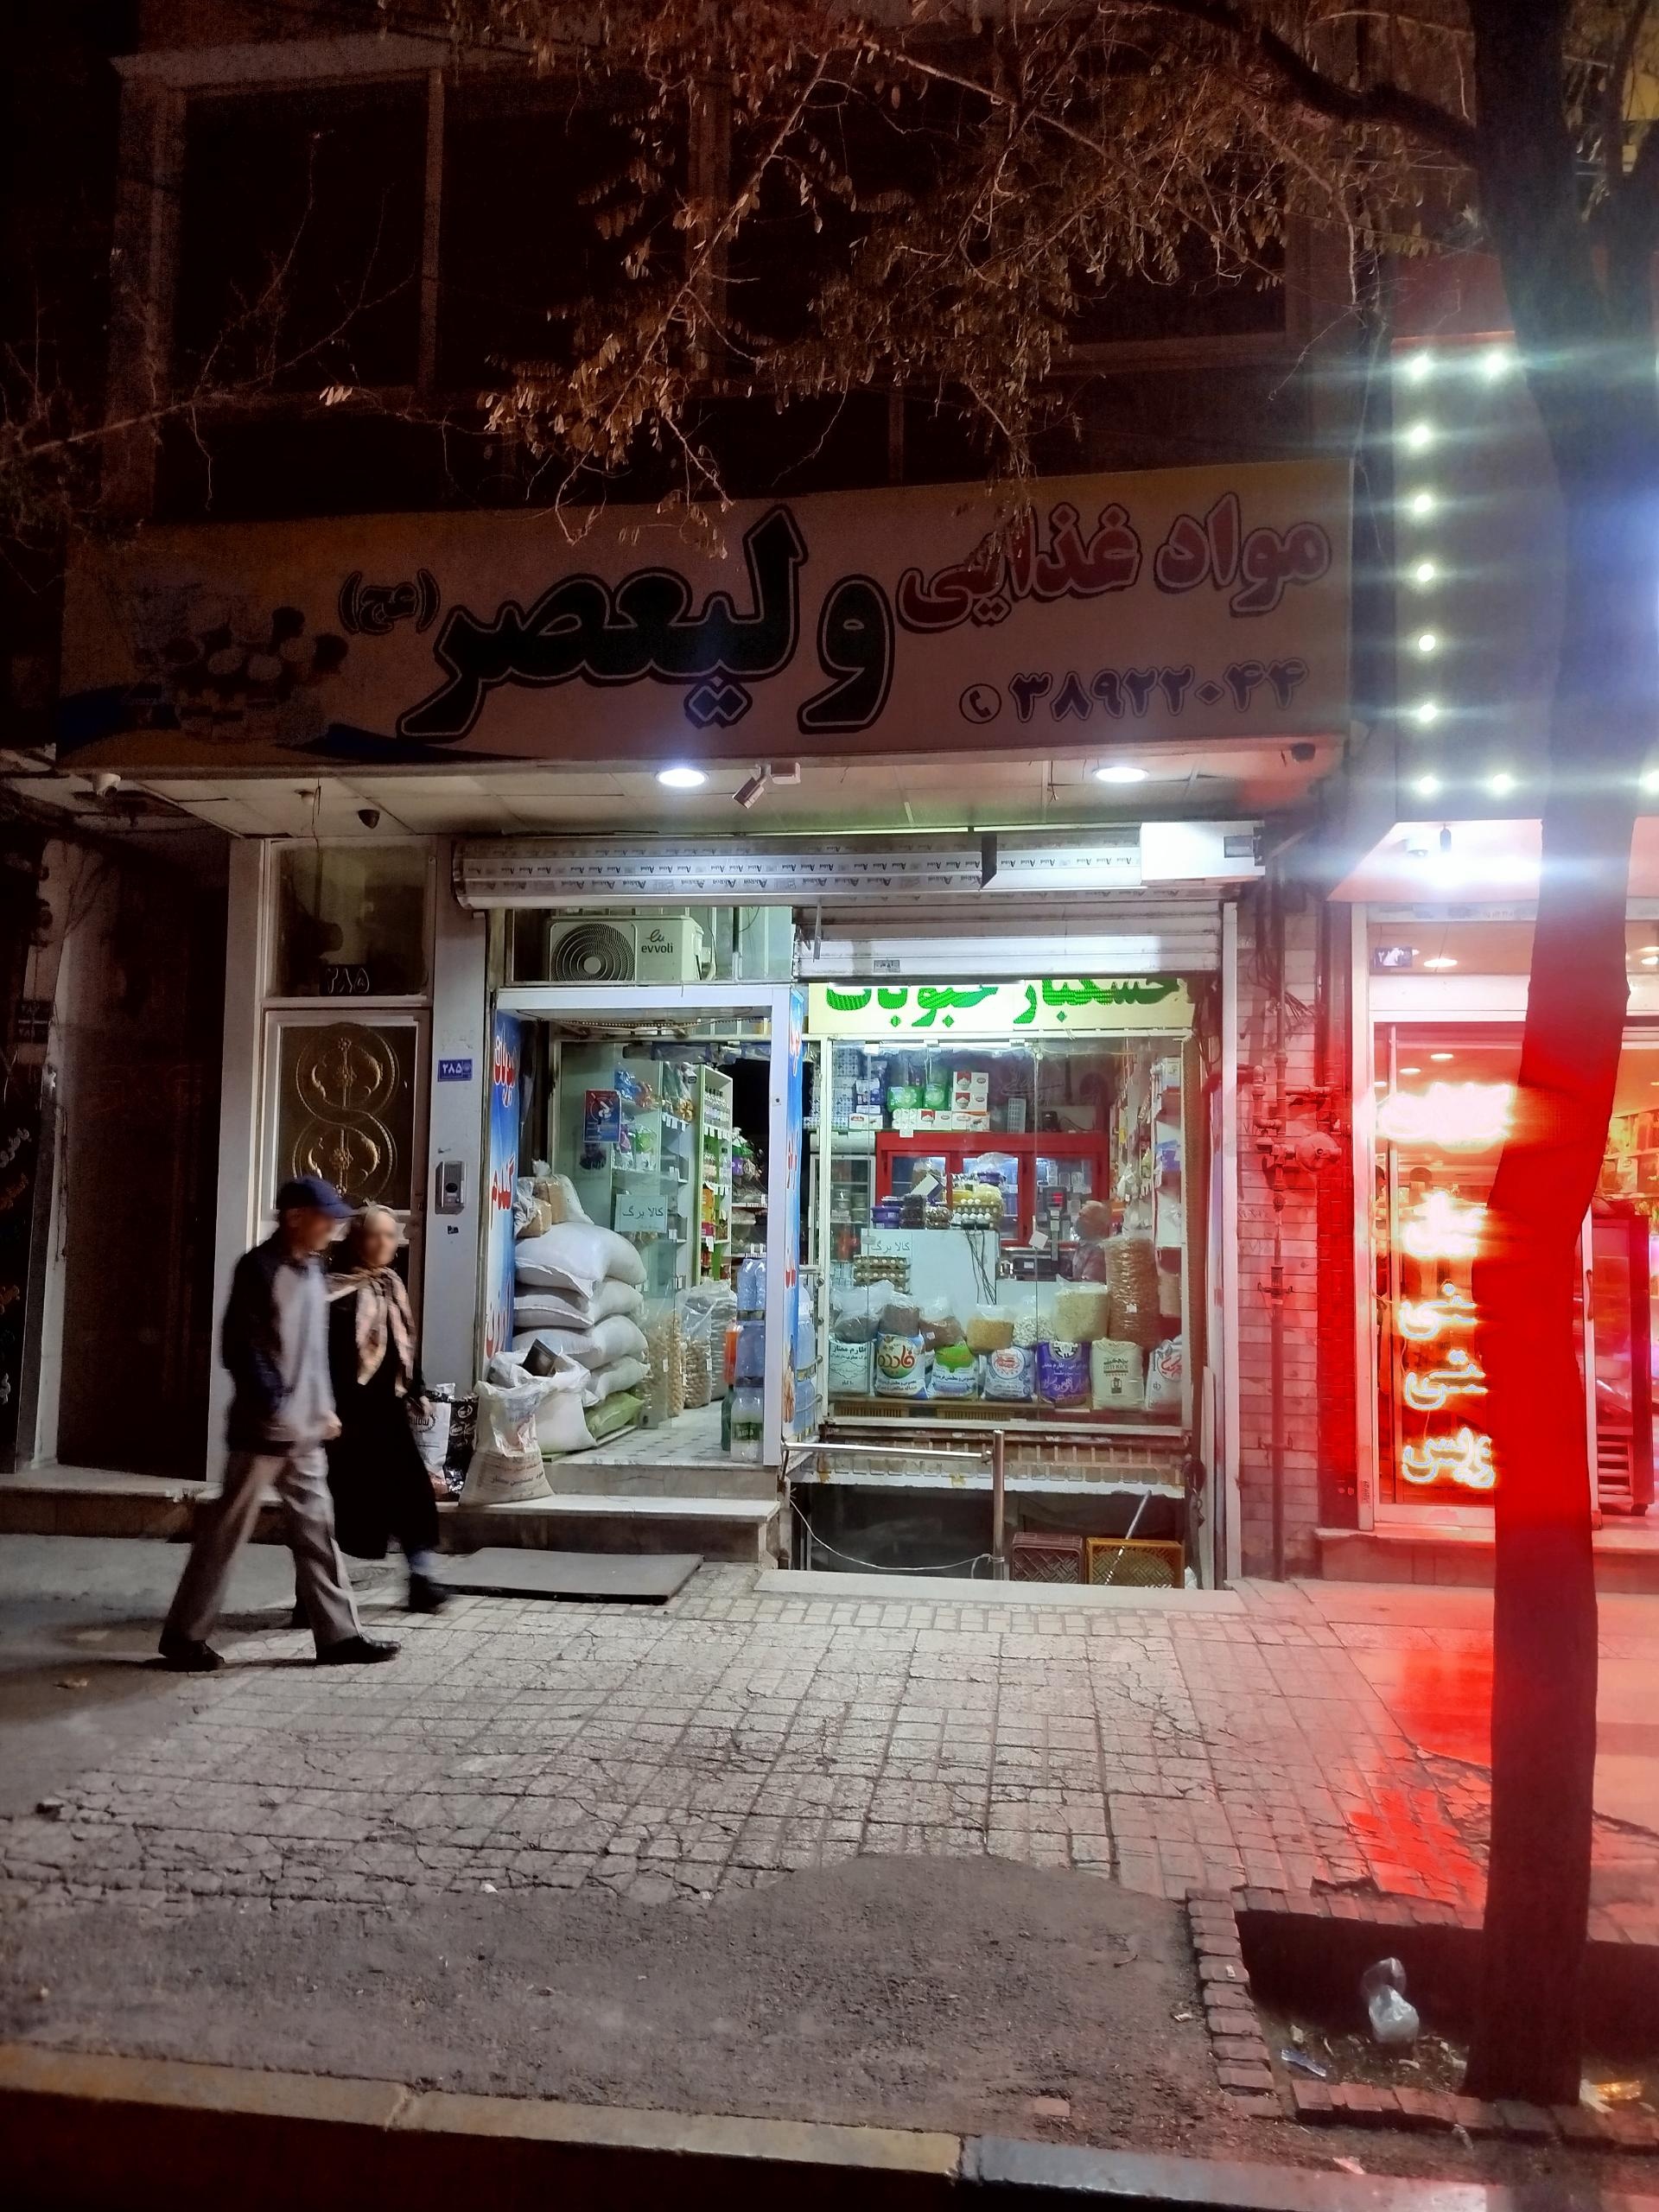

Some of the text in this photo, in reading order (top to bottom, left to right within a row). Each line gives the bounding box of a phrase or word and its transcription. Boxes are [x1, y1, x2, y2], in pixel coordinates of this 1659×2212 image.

[1154, 491, 1332, 617] مواد
[1008, 656, 1310, 723] ۳۸۹۲۲۰۴۴
[641, 943, 673, 953] evvoli
[442, 1063, 462, 1074] ۲۸۵
